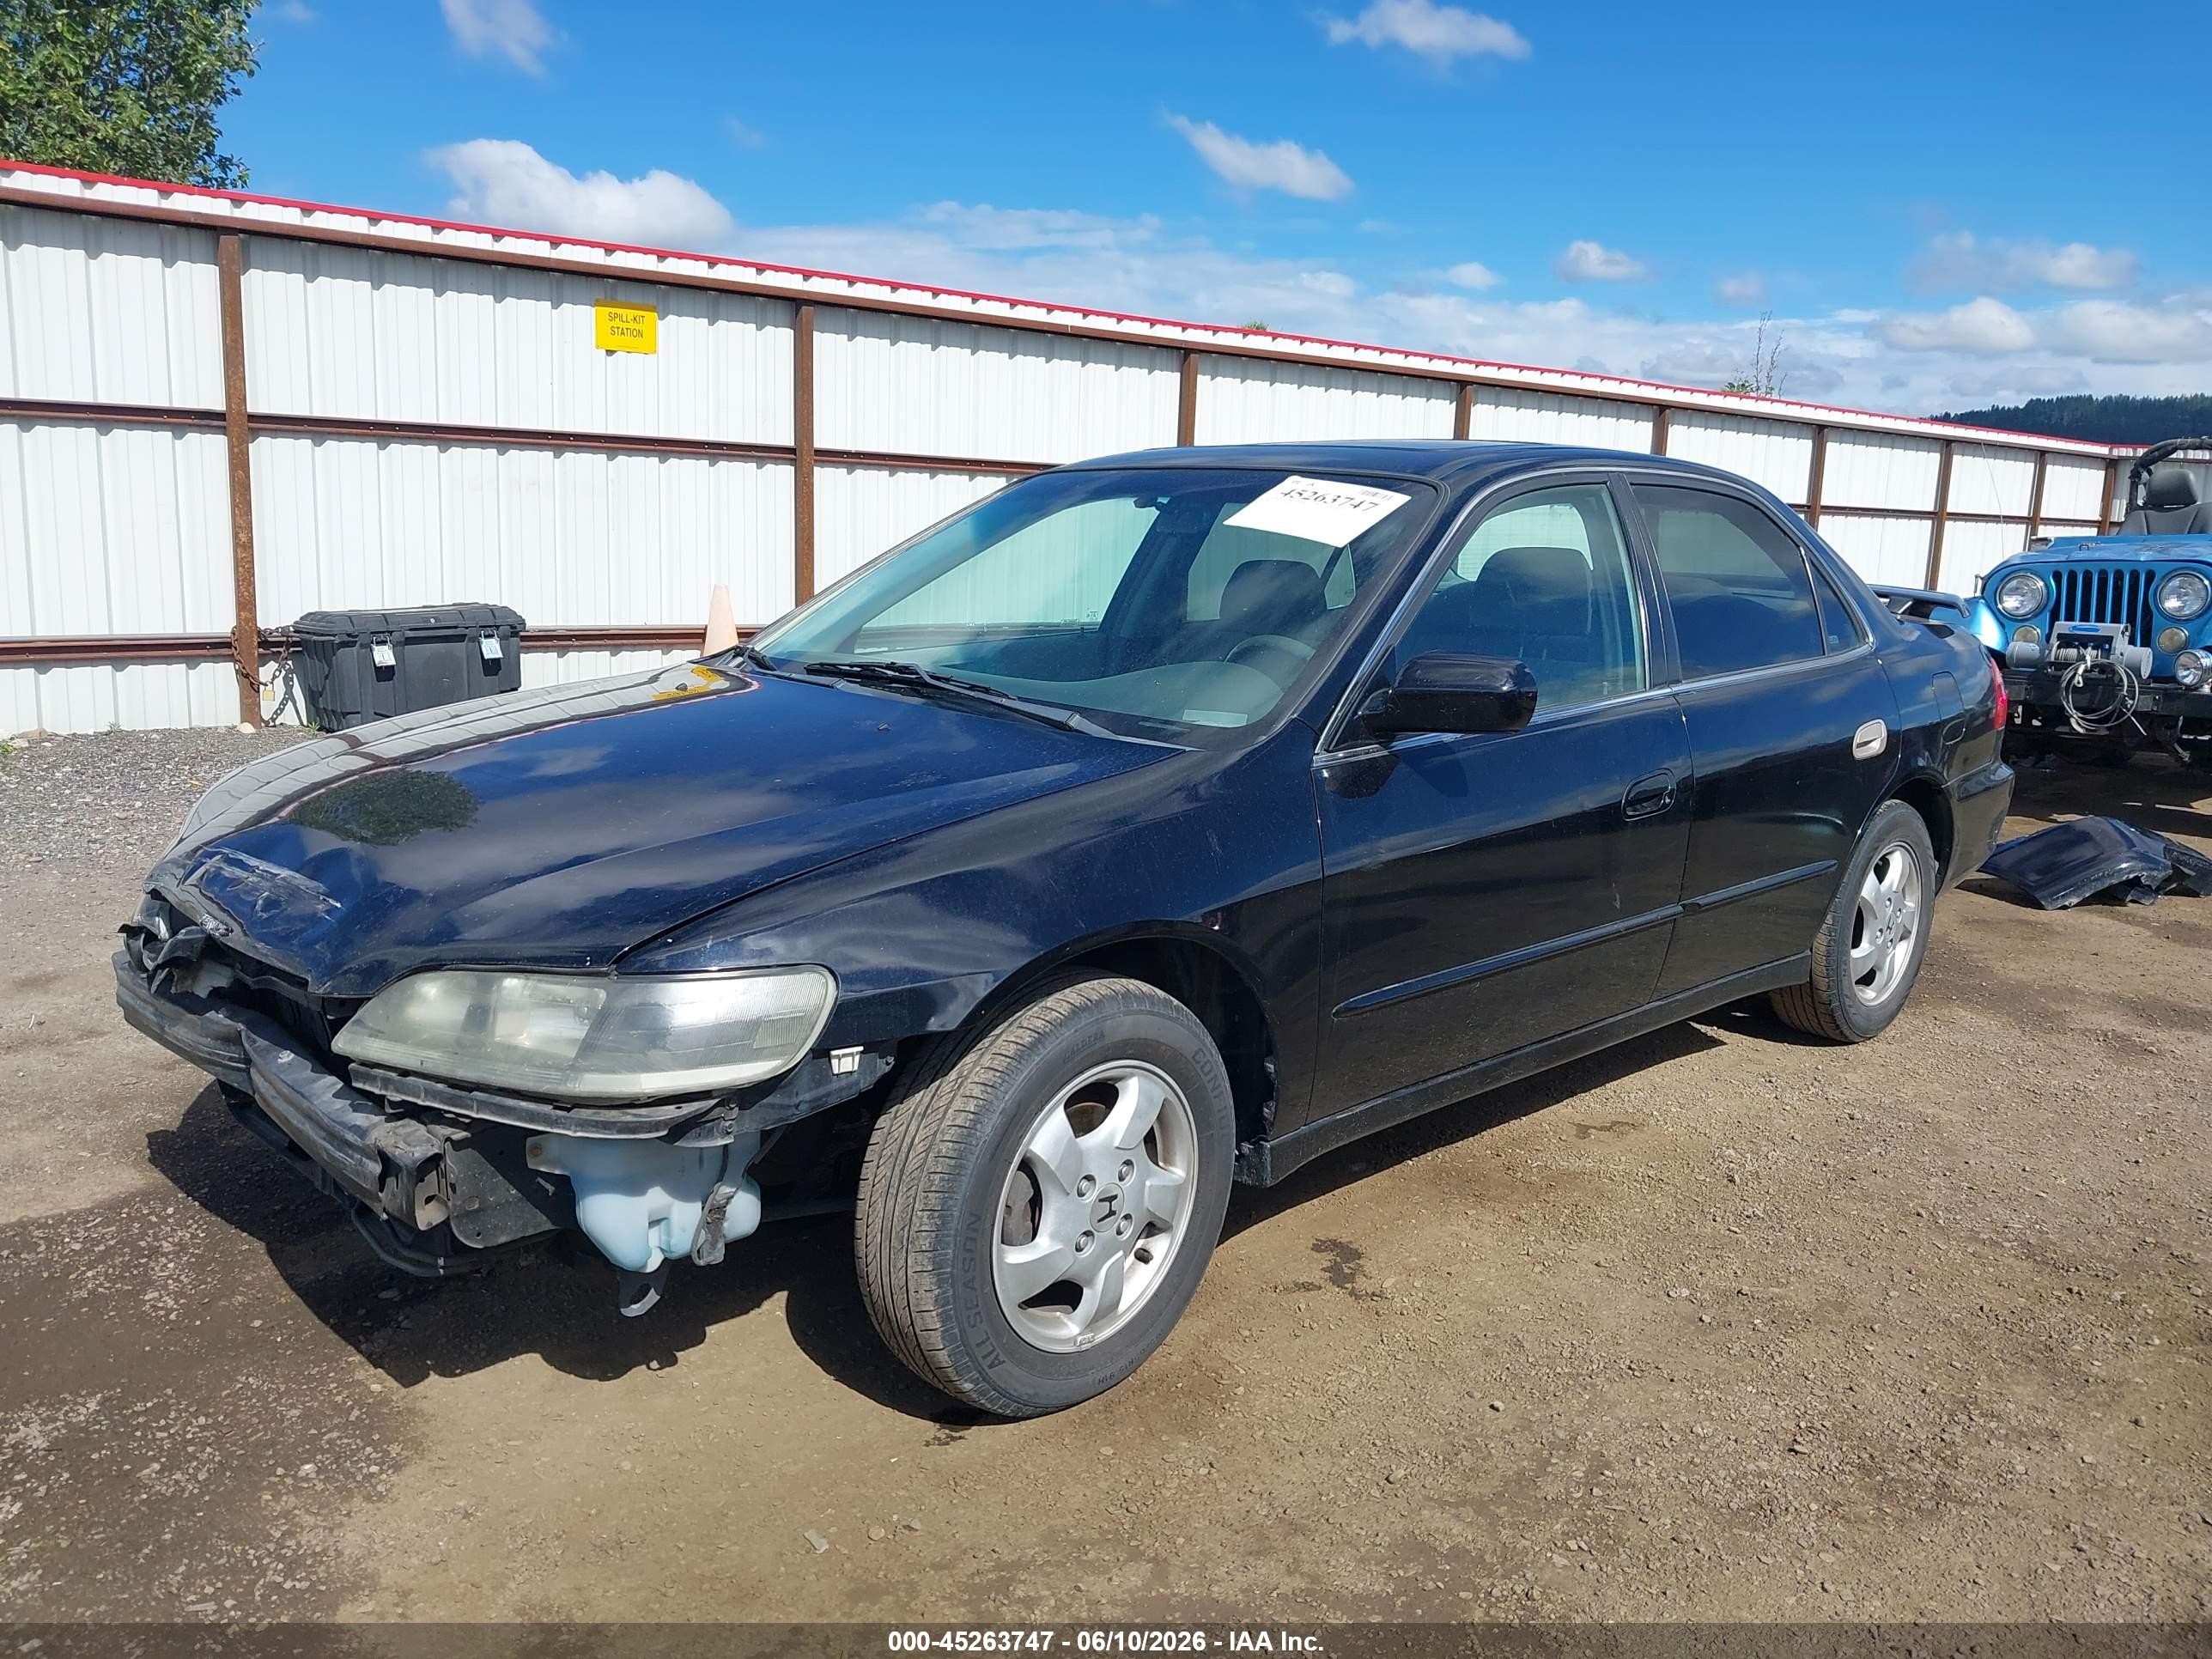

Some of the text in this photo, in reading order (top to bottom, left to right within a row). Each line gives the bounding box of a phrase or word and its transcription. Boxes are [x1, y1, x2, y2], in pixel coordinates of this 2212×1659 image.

[608, 312, 646, 324] SPILL-KIT
[610, 326, 644, 338] STATION
[1280, 489, 1380, 512] 45263747
[962, 1212, 1006, 1370] ALL SEASON
